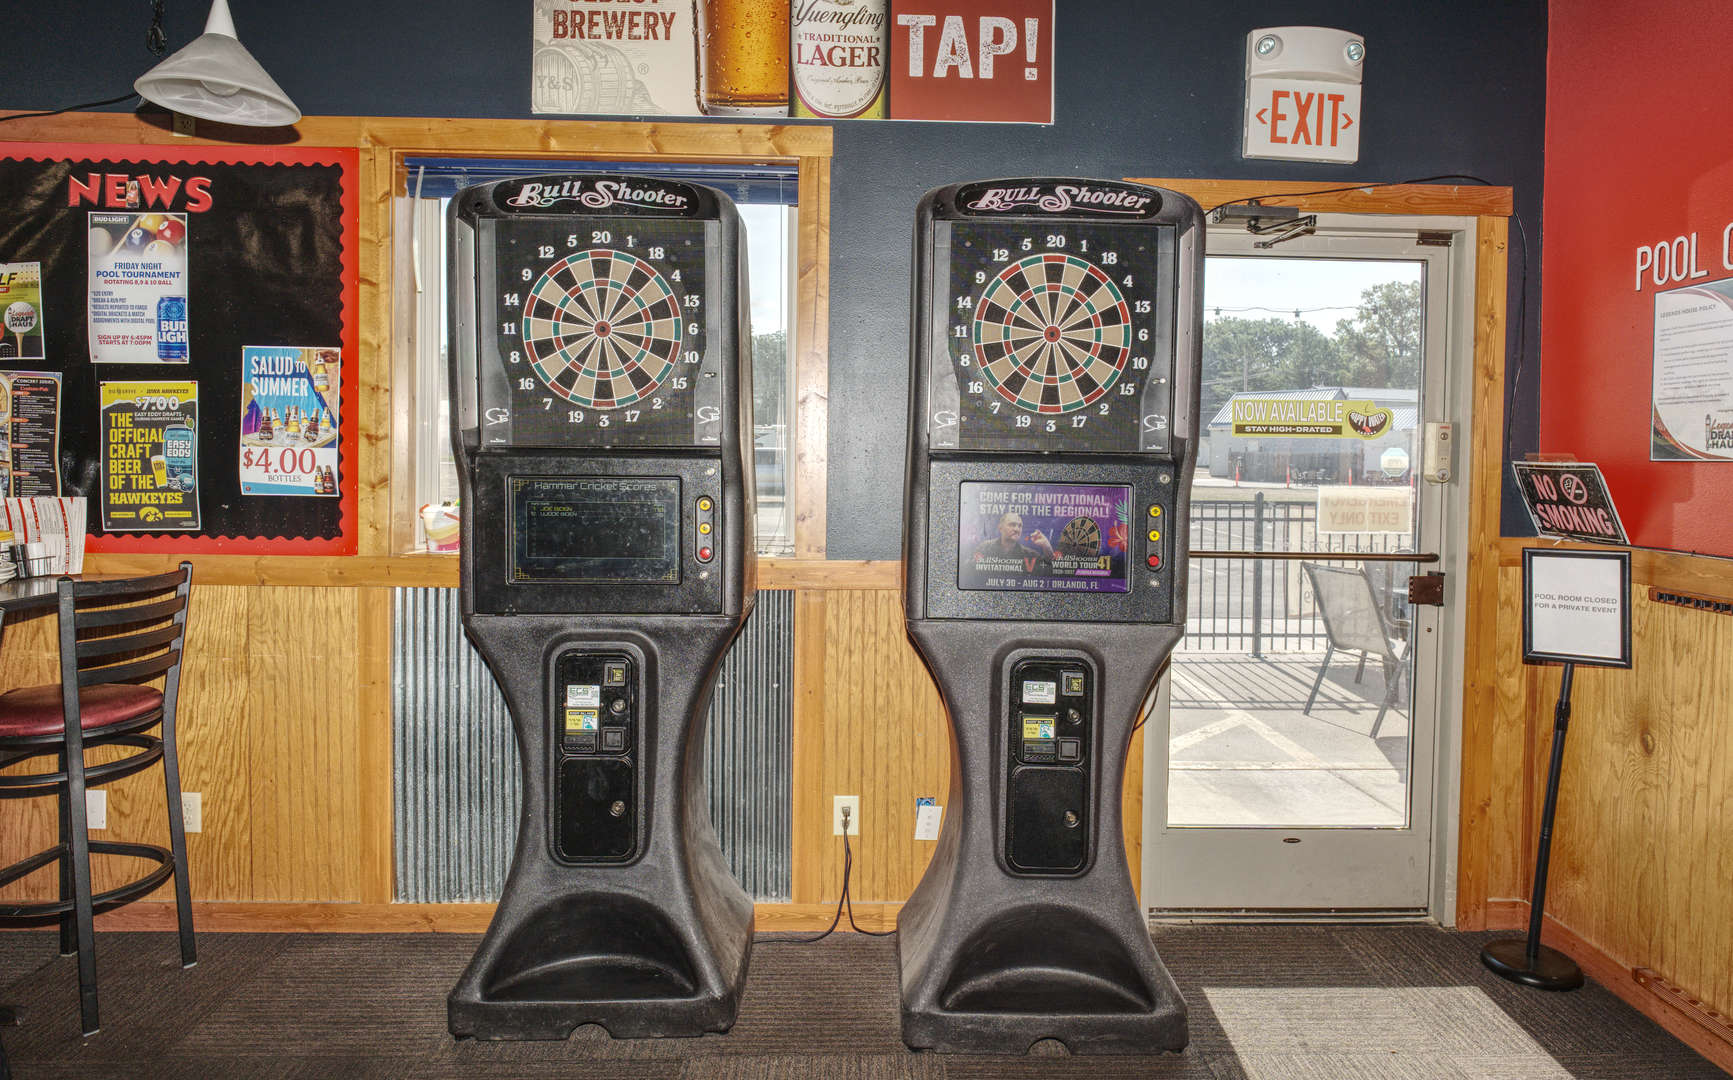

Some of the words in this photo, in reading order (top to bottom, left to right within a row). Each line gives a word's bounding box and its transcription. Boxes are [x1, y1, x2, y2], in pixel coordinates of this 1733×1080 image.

[792, 0, 884, 31] Yuengling
[553, 10, 676, 40] BREWERY
[804, 33, 876, 43] TRADITIONAL
[897, 14, 1039, 80] TAP!
[797, 43, 880, 67] LAGER
[537, 75, 573, 90] Y&S
[1270, 90, 1344, 147] EXIT
[68, 173, 213, 213] NEWS
[581, 181, 687, 208] Shooter
[1039, 185, 1151, 213] Shooter
[568, 234, 578, 248] 5
[592, 230, 612, 244] 20
[626, 234, 634, 248] 1
[1022, 238, 1032, 250] 5
[1046, 234, 1066, 248] 20
[538, 246, 554, 258] 12
[648, 246, 664, 260] 18
[1080, 240, 1088, 252] 1
[992, 248, 1008, 262] 12
[1102, 252, 1118, 264] 18
[1636, 232, 1708, 292] POOL
[522, 268, 532, 282] 9
[670, 270, 680, 282] 4
[976, 272, 986, 284] 9
[1122, 274, 1132, 288] 4
[504, 294, 520, 306] 14
[684, 294, 700, 308] 13
[956, 296, 972, 308] 14
[1134, 300, 1150, 314] 13
[502, 322, 516, 334] 11
[688, 322, 698, 336] 6
[954, 324, 968, 338] 11
[1138, 328, 1148, 342] 6
[510, 350, 520, 364] 8
[682, 350, 700, 364] 10
[960, 354, 970, 366] 8
[1132, 356, 1148, 370] 10
[251, 356, 293, 375] SALUD
[295, 360, 306, 373] TO
[251, 377, 308, 396] SUMMER
[518, 378, 534, 390] 16
[671, 378, 688, 390] 15
[968, 382, 984, 394] 16
[1120, 382, 1134, 396] 15
[542, 398, 552, 410] 7
[652, 396, 664, 410] 2
[990, 402, 1000, 414] 7
[1098, 402, 1110, 416] 2
[568, 410, 584, 424] 19
[624, 410, 640, 422] 17
[1235, 402, 1267, 421] NOW
[1270, 402, 1342, 422] AVAILABLE
[109, 413, 133, 427] THE
[598, 414, 610, 428] 3
[1016, 414, 1032, 428] 19
[1046, 420, 1056, 432] 3
[1072, 414, 1088, 428] 17
[110, 428, 165, 443] OFFICIAL
[110, 444, 151, 458] CRAFT
[167, 440, 191, 448] EASY
[167, 449, 191, 457] EDDY
[110, 459, 142, 474] BEER
[243, 448, 316, 474] $4.00
[110, 475, 126, 489] OF
[130, 475, 154, 489] THE
[534, 482, 576, 490] Hammer
[580, 482, 617, 490] Cricket
[619, 482, 657, 491] Scores
[1532, 474, 1557, 501] NO
[109, 492, 184, 504] HAWKEYES
[980, 492, 1008, 504] COME
[1012, 492, 1032, 504] FOR
[1034, 494, 1110, 506] INVITATIONAL,
[980, 505, 1006, 516] STAY
[1009, 505, 1028, 516] FOR
[1031, 505, 1051, 516] THE
[1054, 506, 1110, 517] REGIONAL!
[1536, 503, 1615, 536] SMOKING
[1024, 557, 1036, 572] V
[986, 578, 1005, 586] JULY
[1023, 579, 1038, 587] AUG
[1052, 580, 1089, 589] ORLANDO,
[1091, 581, 1098, 589] FL
[1584, 596, 1617, 604] CLOSED
[1559, 604, 1590, 612] PRIVATE
